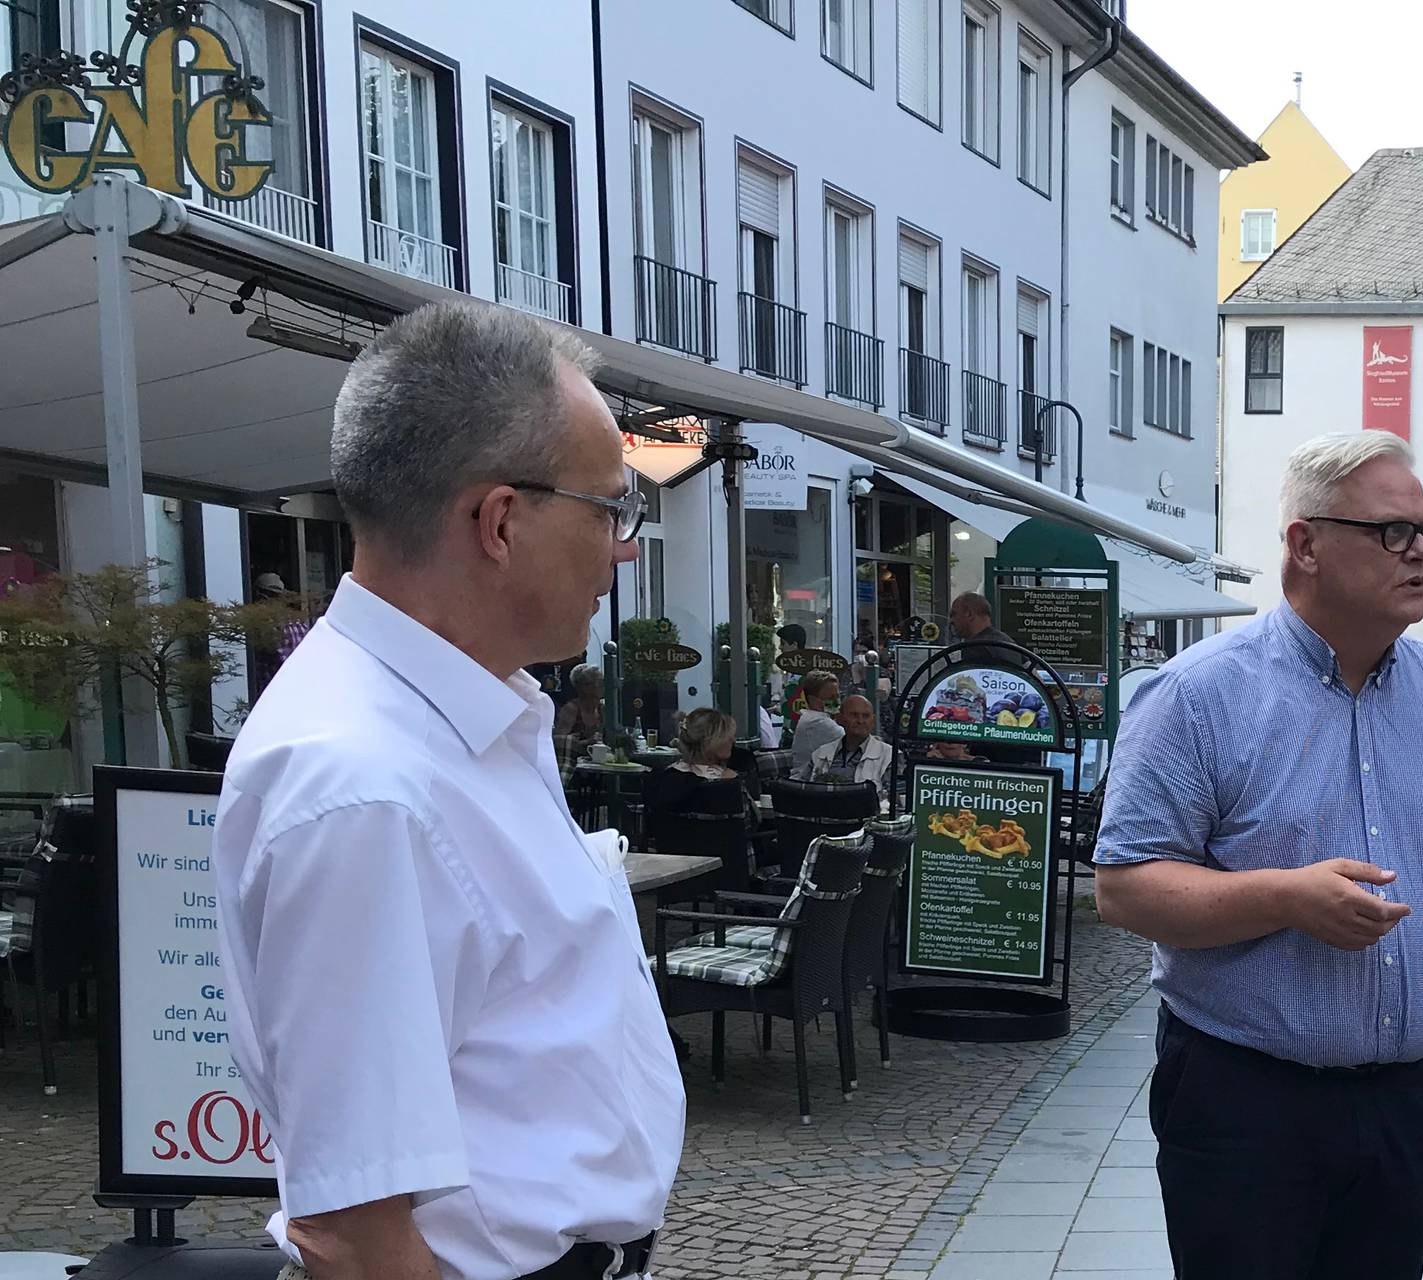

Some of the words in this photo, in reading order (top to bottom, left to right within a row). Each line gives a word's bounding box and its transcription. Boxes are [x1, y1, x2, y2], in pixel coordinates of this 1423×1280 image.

[1024, 591, 1080, 600] Pfannekuchen
[1034, 604, 1069, 612] Schnitzel
[1023, 618, 1080, 627] Ofenkartoffeln
[982, 676, 1026, 691] Saison
[923, 719, 978, 731] Grillagetorte
[983, 726, 1054, 743] Pflaumenkuchen
[920, 774, 971, 787] Gerichte
[974, 778, 993, 789] mit
[997, 780, 1044, 793] frischen
[920, 789, 1043, 815] Pfifferlingen
[137, 853, 168, 869] Wir
[174, 856, 210, 871] sind
[921, 850, 981, 862] Pfannekuchen
[1007, 859, 1014, 867] €
[1018, 860, 1042, 869] 10.50
[921, 872, 976, 884] Sommersalat
[1006, 880, 1013, 888] €
[1018, 881, 1041, 890] 10.95
[183, 891, 217, 908] Uns
[920, 902, 973, 914] Ofenkartoffel
[1005, 911, 1012, 920] €
[1016, 912, 1040, 922] 11.95
[919, 932, 995, 946] Schweineschnitzel
[1003, 939, 1010, 948] €
[1015, 940, 1038, 950] 14.95
[157, 949, 188, 965] Wir
[164, 1004, 197, 1021] den
[204, 1007, 226, 1022] Au
[153, 1027, 186, 1042] und
[196, 1062, 222, 1077] Ihr
